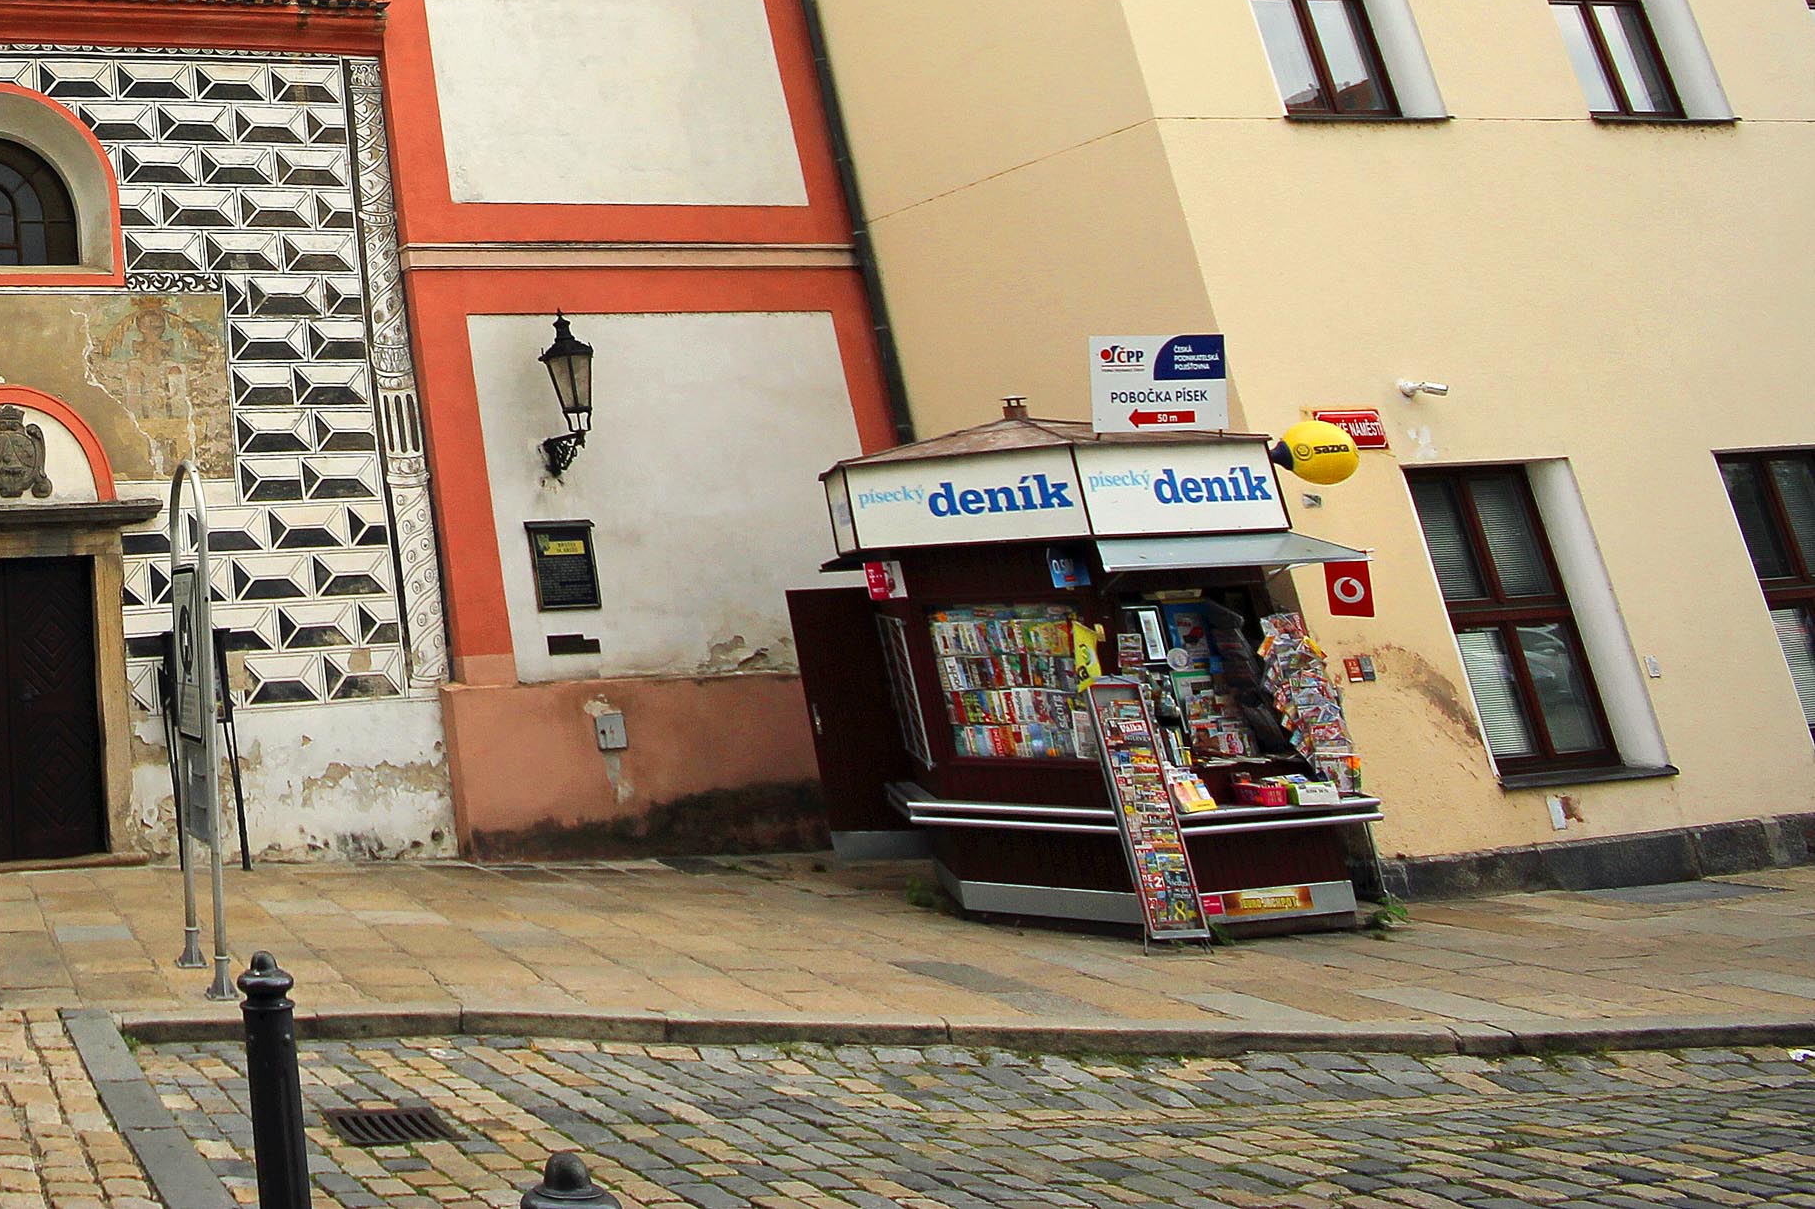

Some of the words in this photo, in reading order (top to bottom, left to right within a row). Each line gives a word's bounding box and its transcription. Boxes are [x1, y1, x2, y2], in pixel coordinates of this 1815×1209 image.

[1117, 347, 1144, 363] ČPP
[1173, 345, 1192, 353] ČESKÁ
[1110, 388, 1172, 403] POBOČKA
[1176, 387, 1208, 402] PÍSEK
[1157, 414, 1168, 422] 50
[1088, 469, 1150, 492] písecký
[1154, 466, 1272, 504] deník
[858, 484, 925, 509] písecký
[928, 473, 1074, 517] deník
